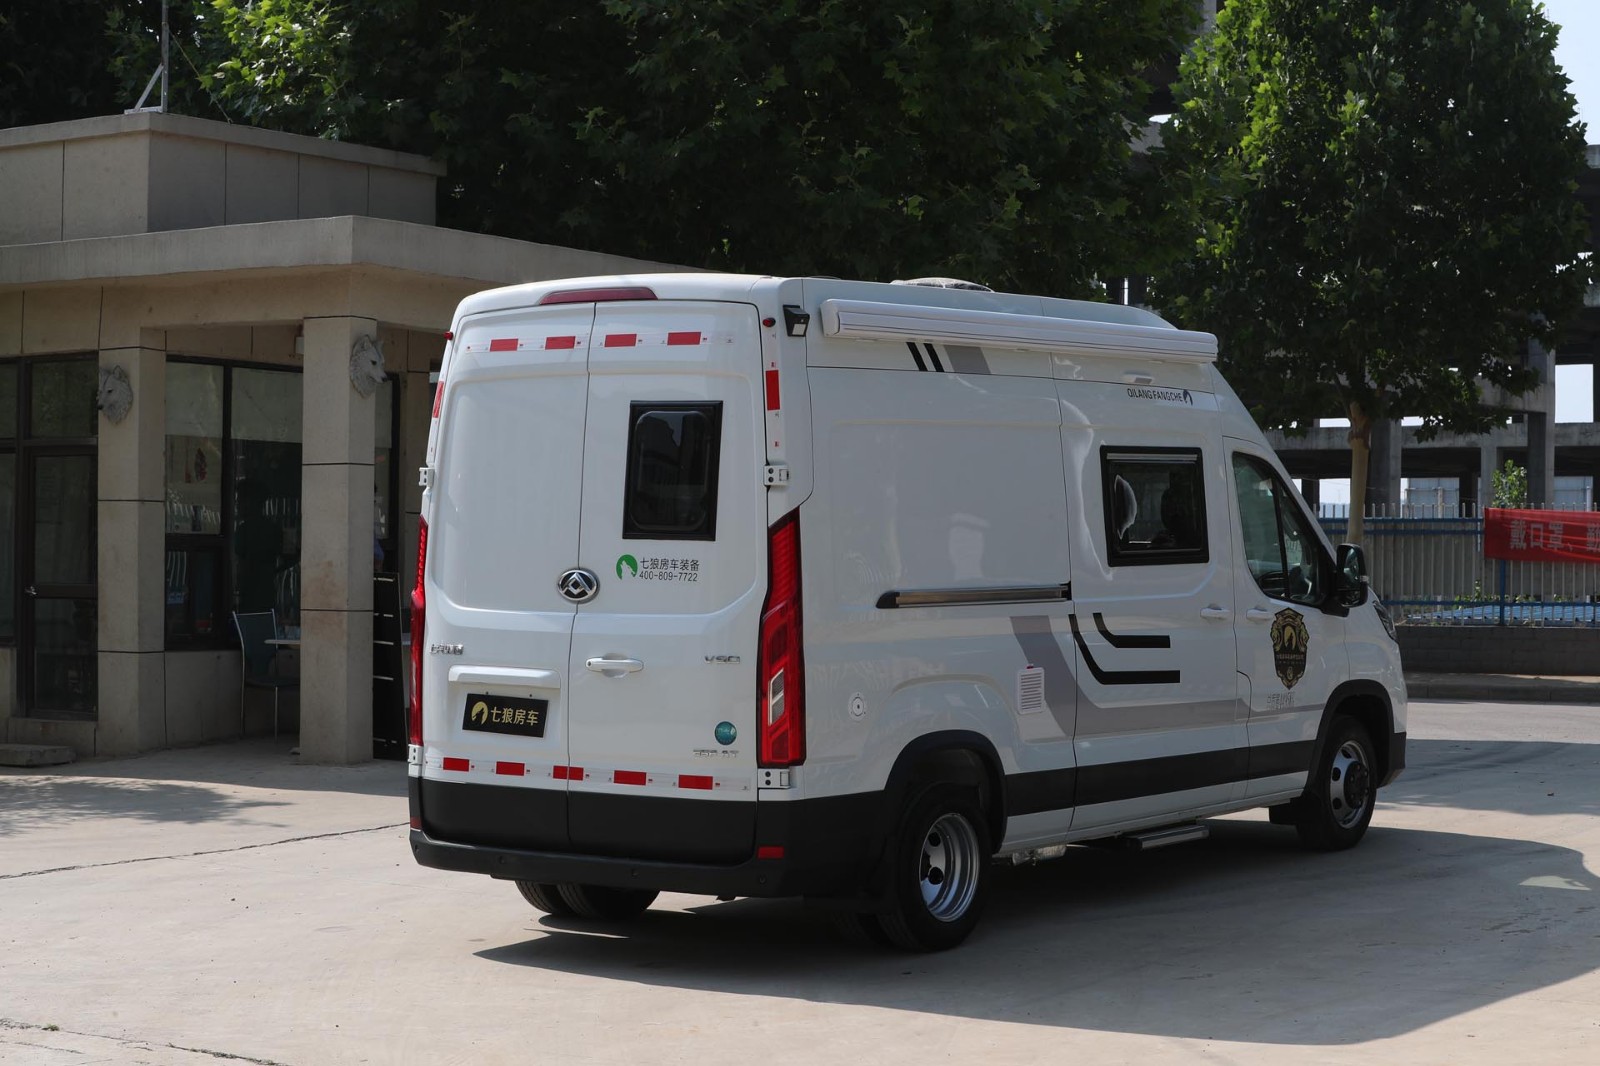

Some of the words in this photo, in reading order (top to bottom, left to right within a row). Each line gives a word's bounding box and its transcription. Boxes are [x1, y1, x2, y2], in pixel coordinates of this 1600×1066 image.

[1127, 388, 1153, 400] QILANG
[1153, 390, 1183, 402] FANGCHE
[640, 557, 700, 572] 七狼房车装备
[639, 570, 698, 582] 400-809-7722
[490, 706, 539, 726] 七狼房车
